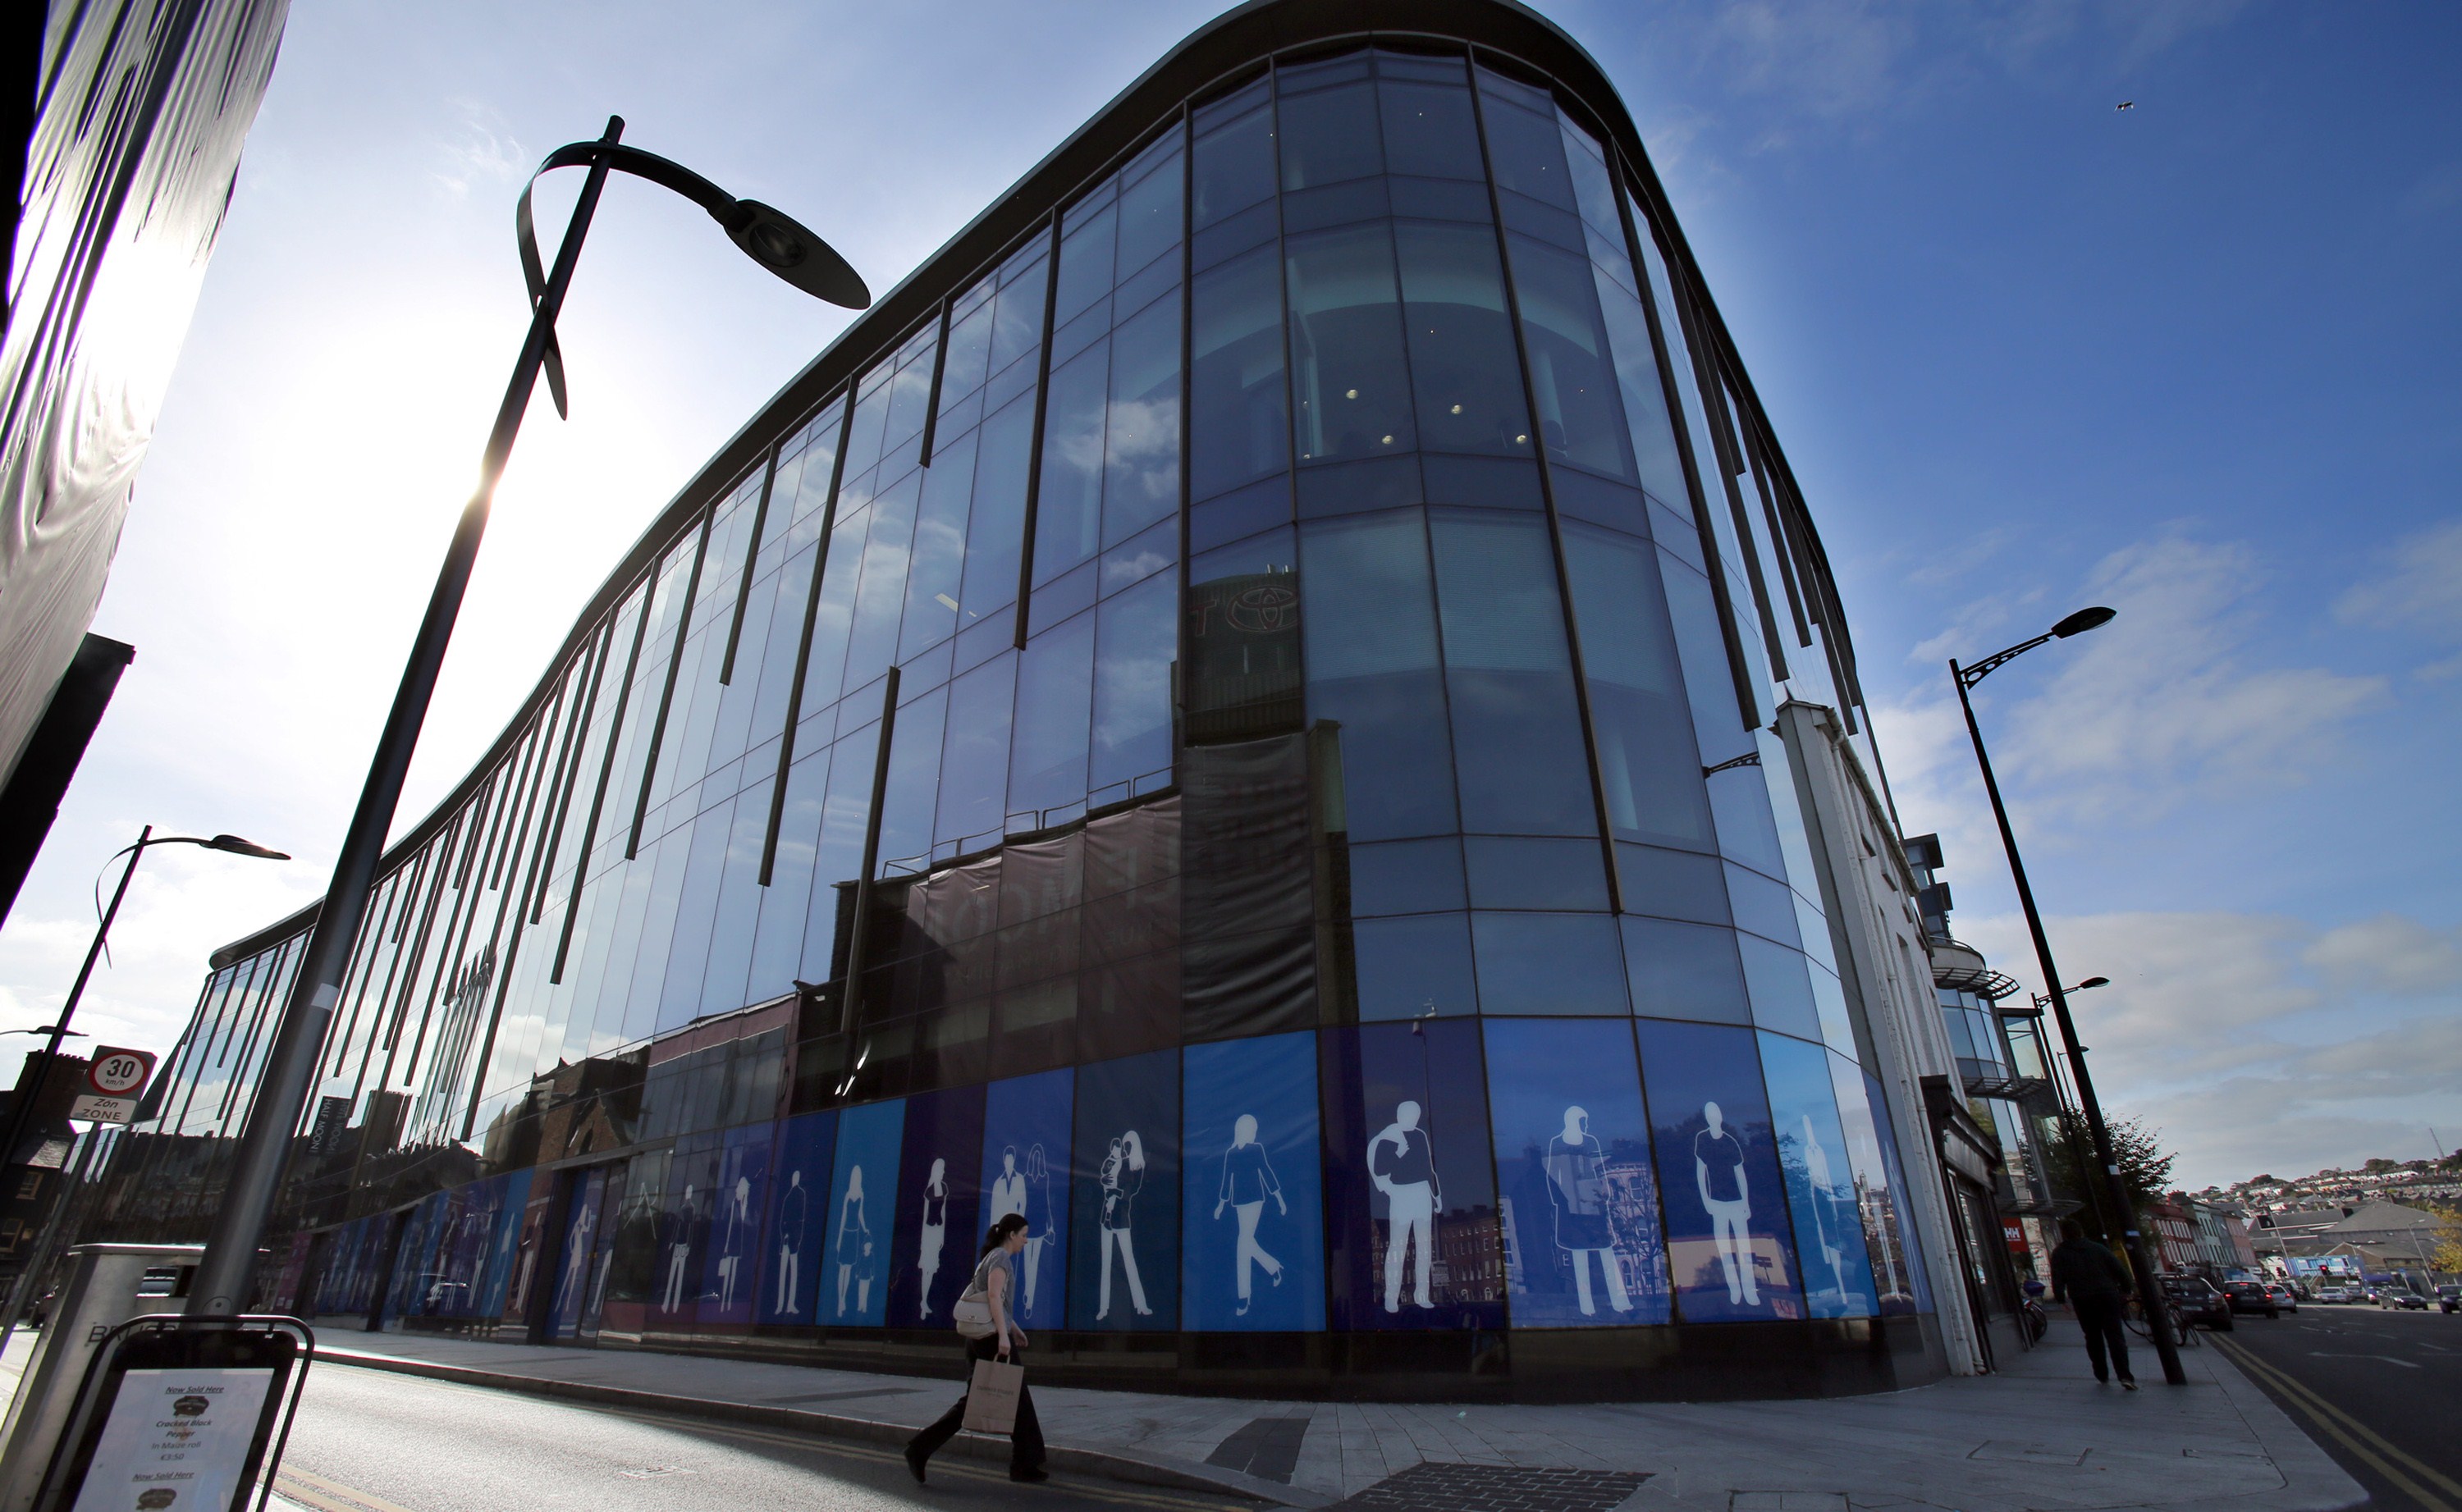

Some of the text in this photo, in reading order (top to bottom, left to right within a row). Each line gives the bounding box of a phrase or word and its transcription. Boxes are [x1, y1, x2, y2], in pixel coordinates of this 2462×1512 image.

[107, 1059, 135, 1078] 30
[94, 1099, 119, 1108] Zón
[83, 1108, 121, 1121] ZONE
[2004, 1227, 2020, 1239] HH
